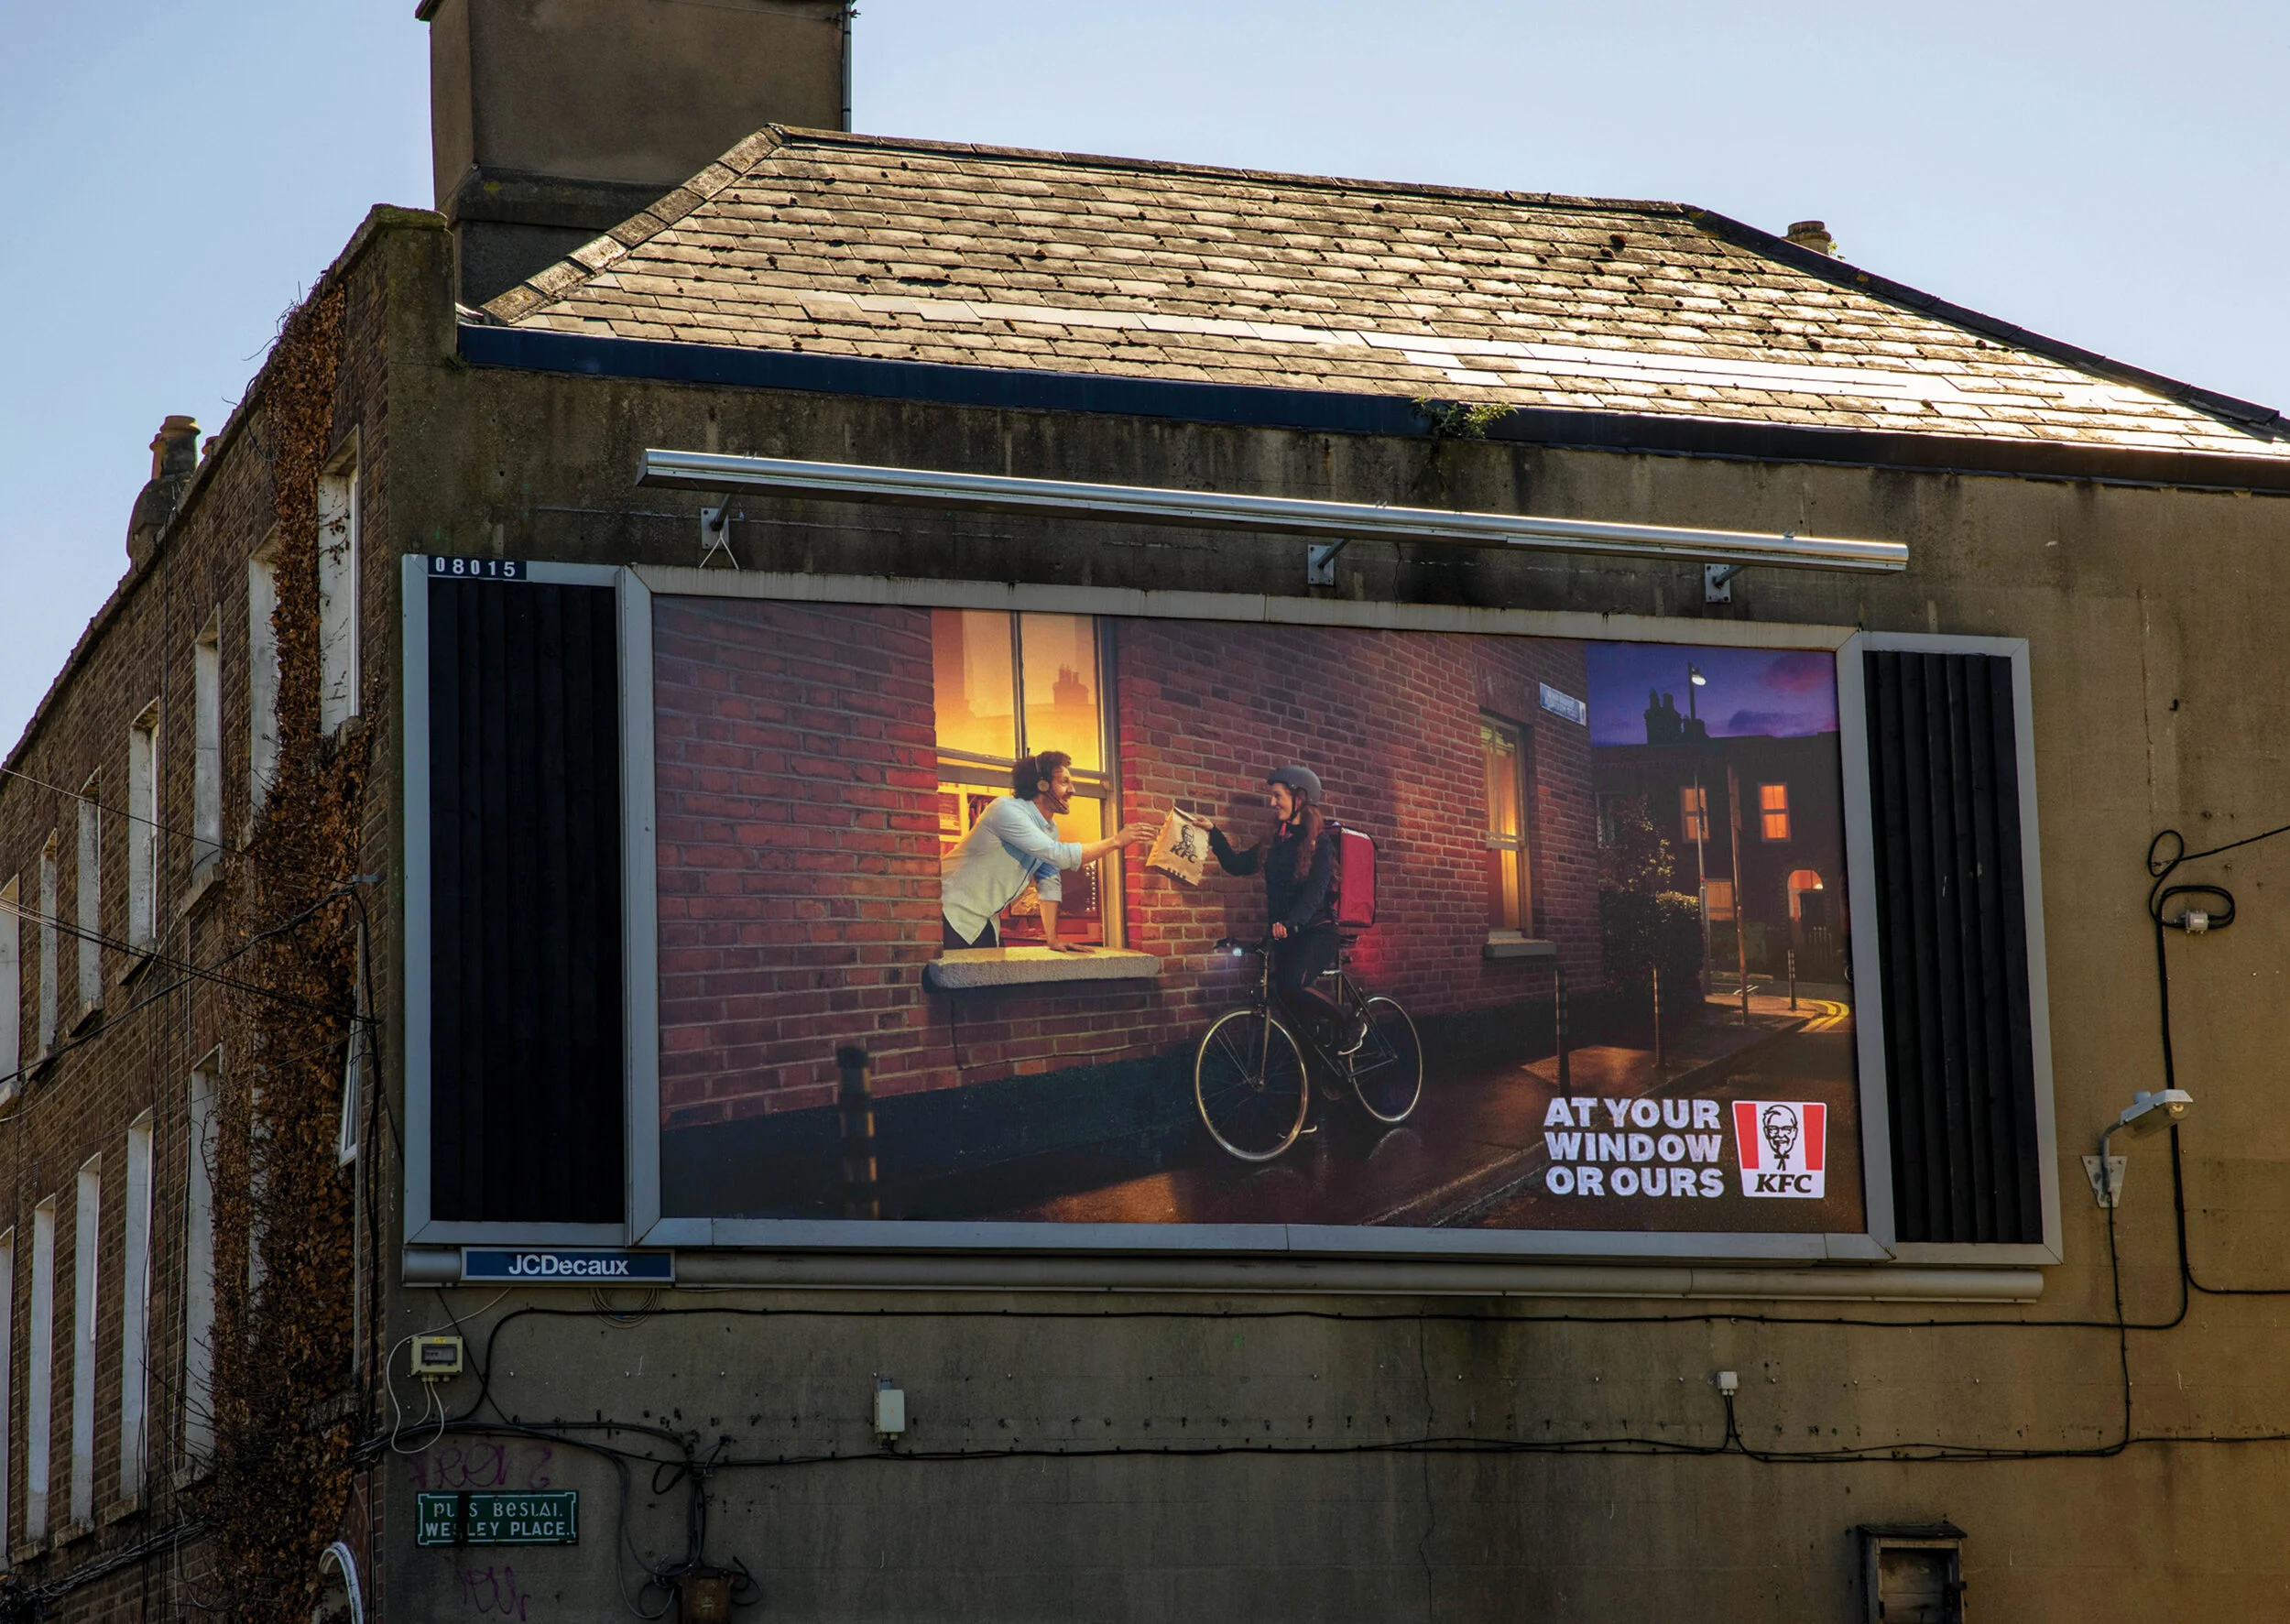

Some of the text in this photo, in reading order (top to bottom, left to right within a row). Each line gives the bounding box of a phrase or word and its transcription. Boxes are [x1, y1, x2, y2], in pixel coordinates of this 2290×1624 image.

[435, 556, 516, 577] 08015
[1169, 845, 1199, 864] KFC
[1543, 1097, 1721, 1129] AT YOUR
[1543, 1131, 1723, 1162] WINDOW
[1545, 1166, 1725, 1198] OR OURS
[1754, 1173, 1813, 1193] KFC
[508, 1254, 629, 1276] JCDecaux
[433, 1502, 478, 1518] PLS
